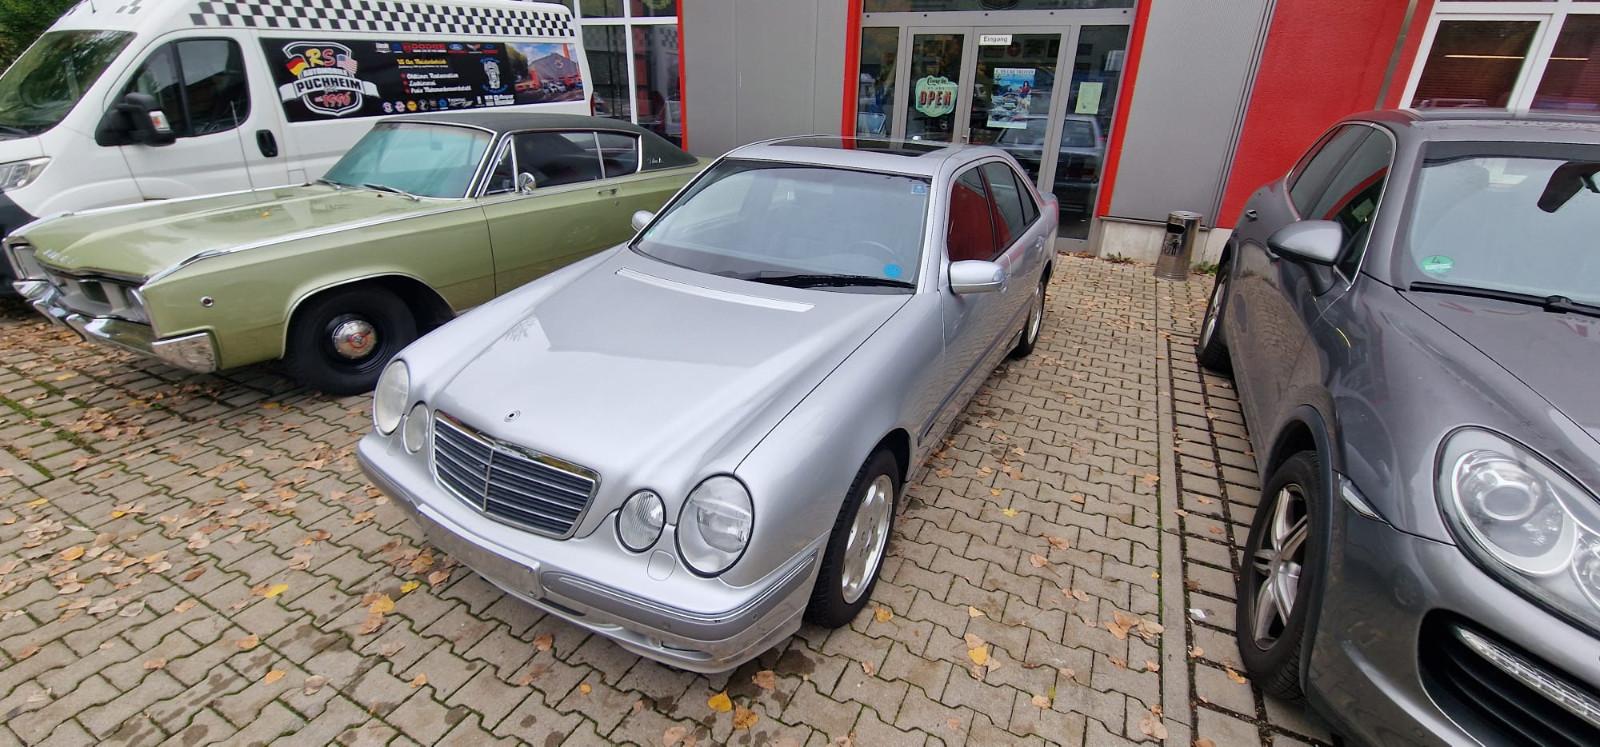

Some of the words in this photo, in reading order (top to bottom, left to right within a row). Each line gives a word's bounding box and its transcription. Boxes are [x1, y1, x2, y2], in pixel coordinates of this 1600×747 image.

[305, 48, 336, 67] RS
[296, 77, 361, 92] PUCHHEIM
[920, 91, 952, 106] OPEN
